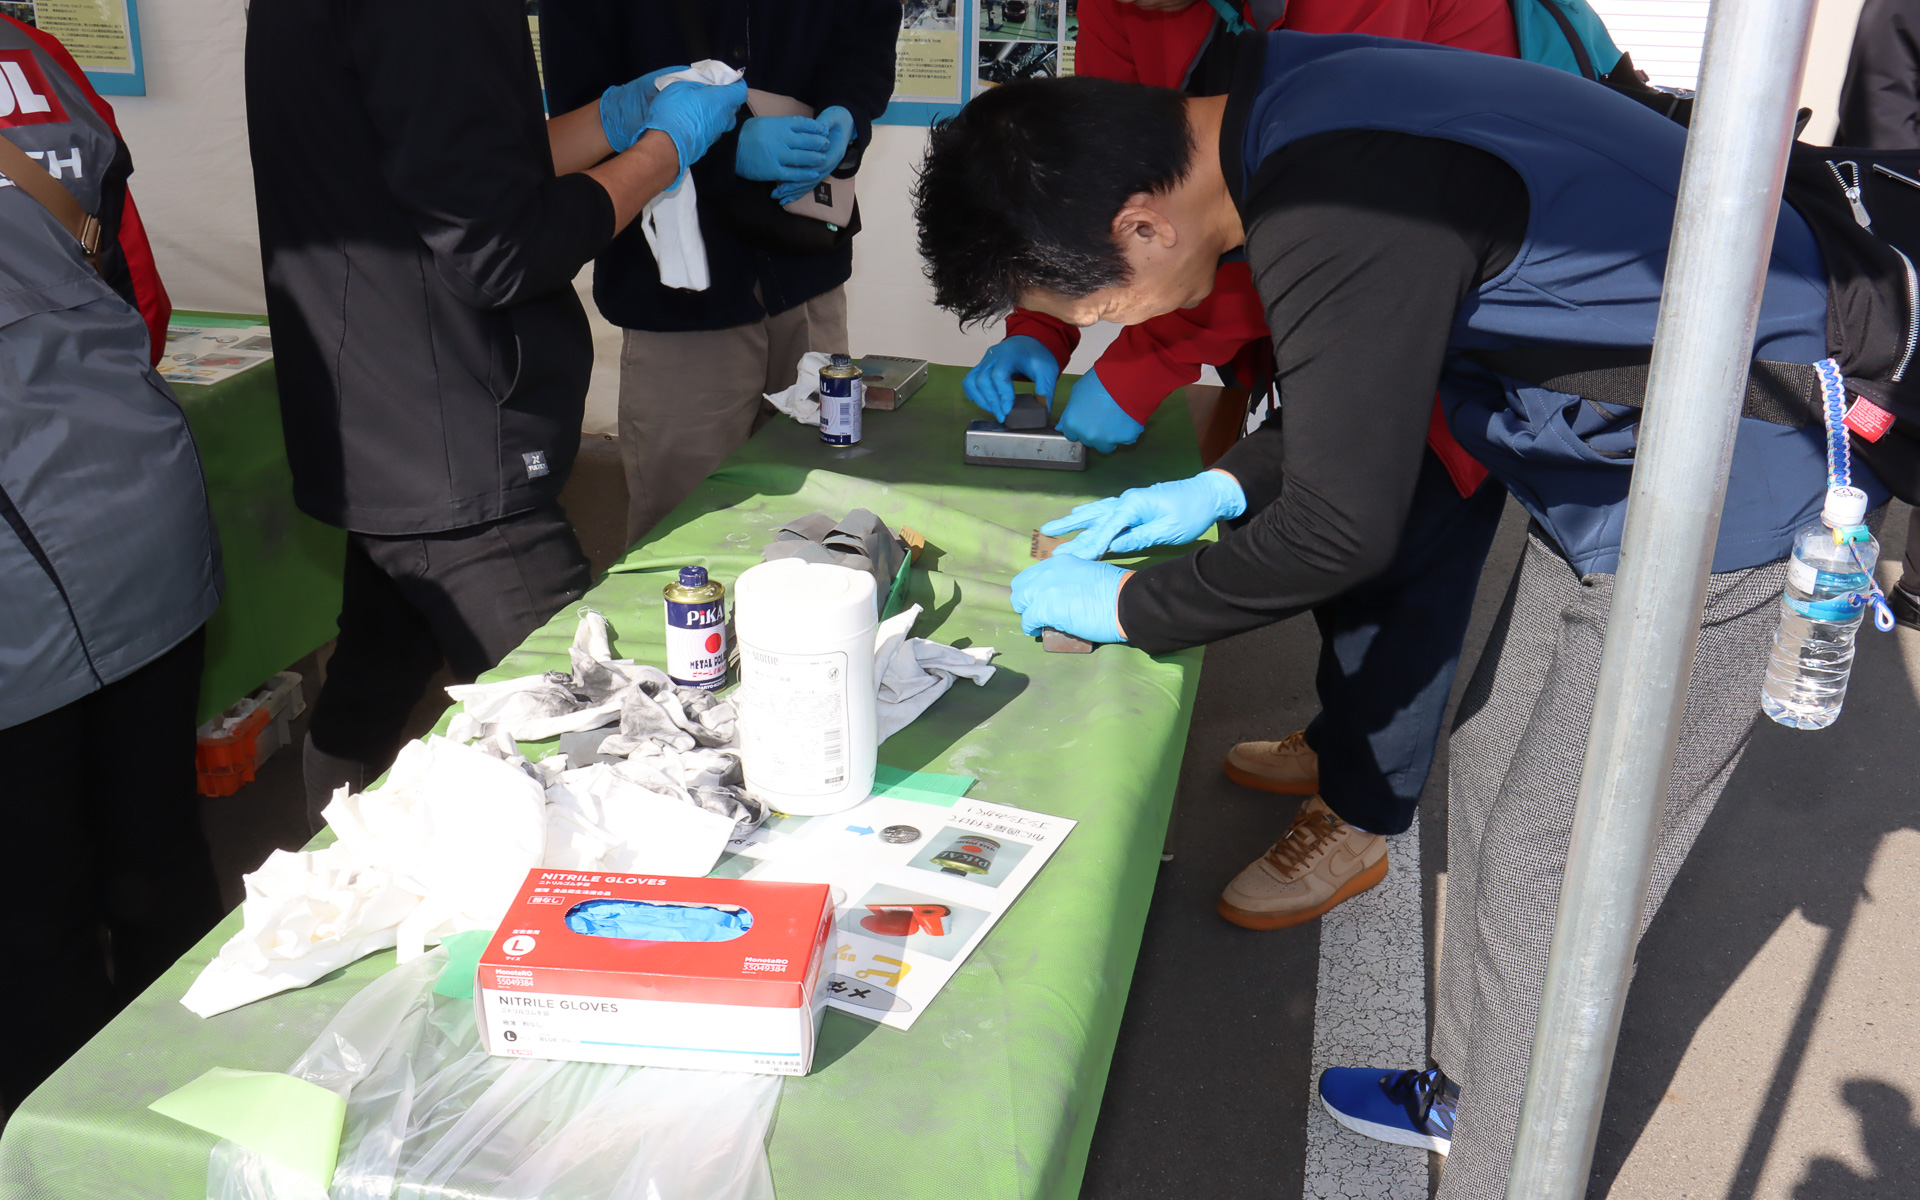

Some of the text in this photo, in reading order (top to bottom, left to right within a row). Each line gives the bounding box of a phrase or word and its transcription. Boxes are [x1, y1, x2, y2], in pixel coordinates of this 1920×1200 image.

[686, 605, 724, 626] PiKA
[690, 658, 713, 670] METAL
[541, 873, 667, 886] NITRILE GLOVES
[511, 939, 524, 951] L
[745, 956, 789, 965] MonotaRO
[495, 968, 533, 977] MonotaRO
[742, 964, 787, 973] 55049384
[497, 978, 534, 987] 55049384
[499, 996, 619, 1013] NITRILE GLOVES
